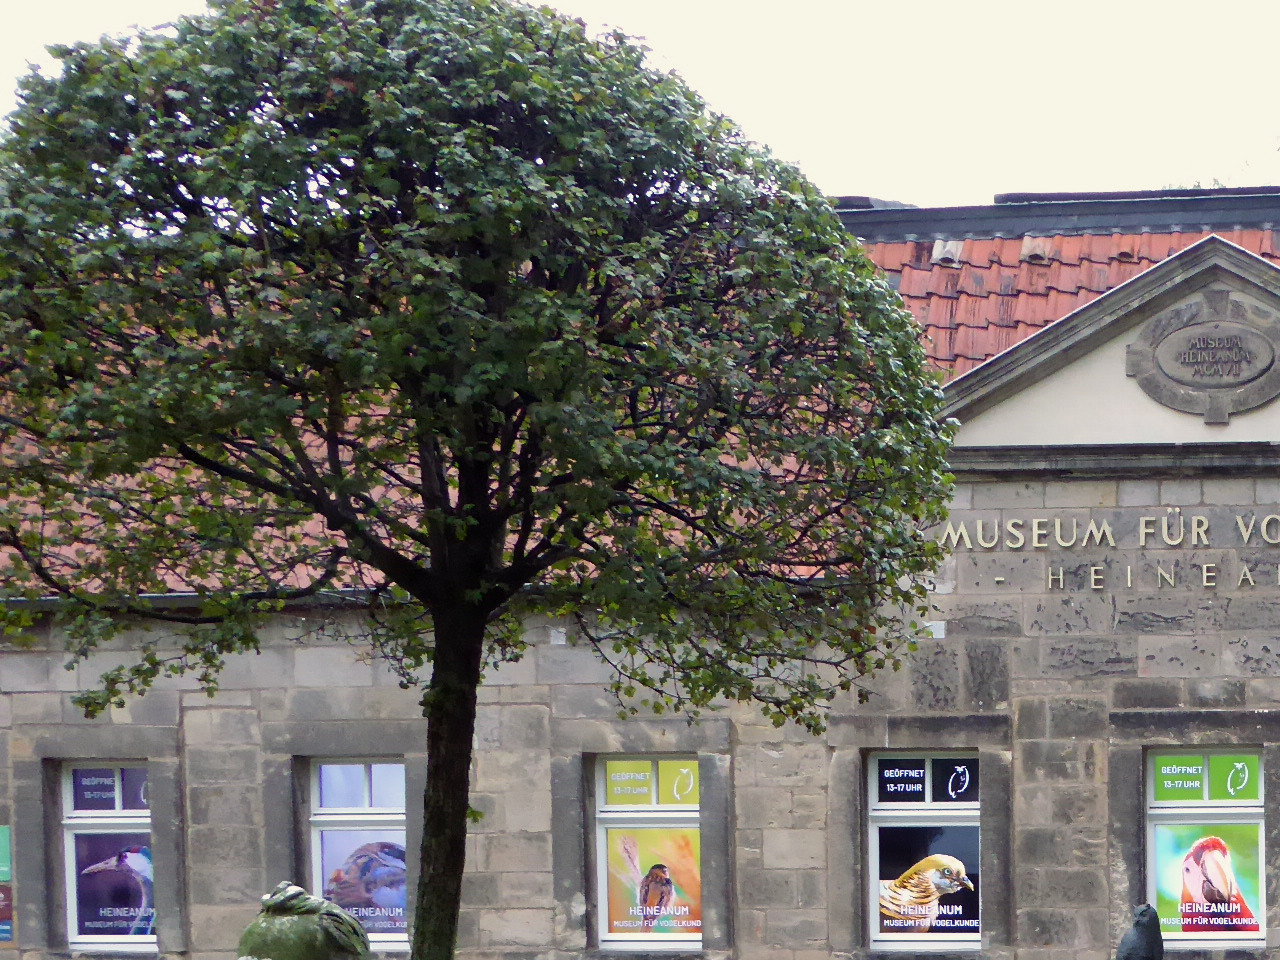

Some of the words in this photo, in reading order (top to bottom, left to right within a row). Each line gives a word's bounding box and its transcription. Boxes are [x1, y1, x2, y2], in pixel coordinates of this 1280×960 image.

[1189, 336, 1242, 350] MUSEUM
[941, 518, 1116, 549] MUSEUM
[1138, 509, 1209, 546] FÜR
[884, 769, 924, 777] GEÖFFNET
[1161, 765, 1202, 774] GEÖFFNET
[611, 772, 650, 780] GEÖFFNET
[100, 907, 156, 916] HEINEANUM
[629, 906, 689, 915] HEINEANUM
[901, 905, 962, 914] HEINEANUM
[1178, 903, 1240, 913] HEINEANUM
[644, 919, 658, 927] FÜR
[915, 918, 930, 926] FÜR
[1193, 916, 1207, 925] FÜR
